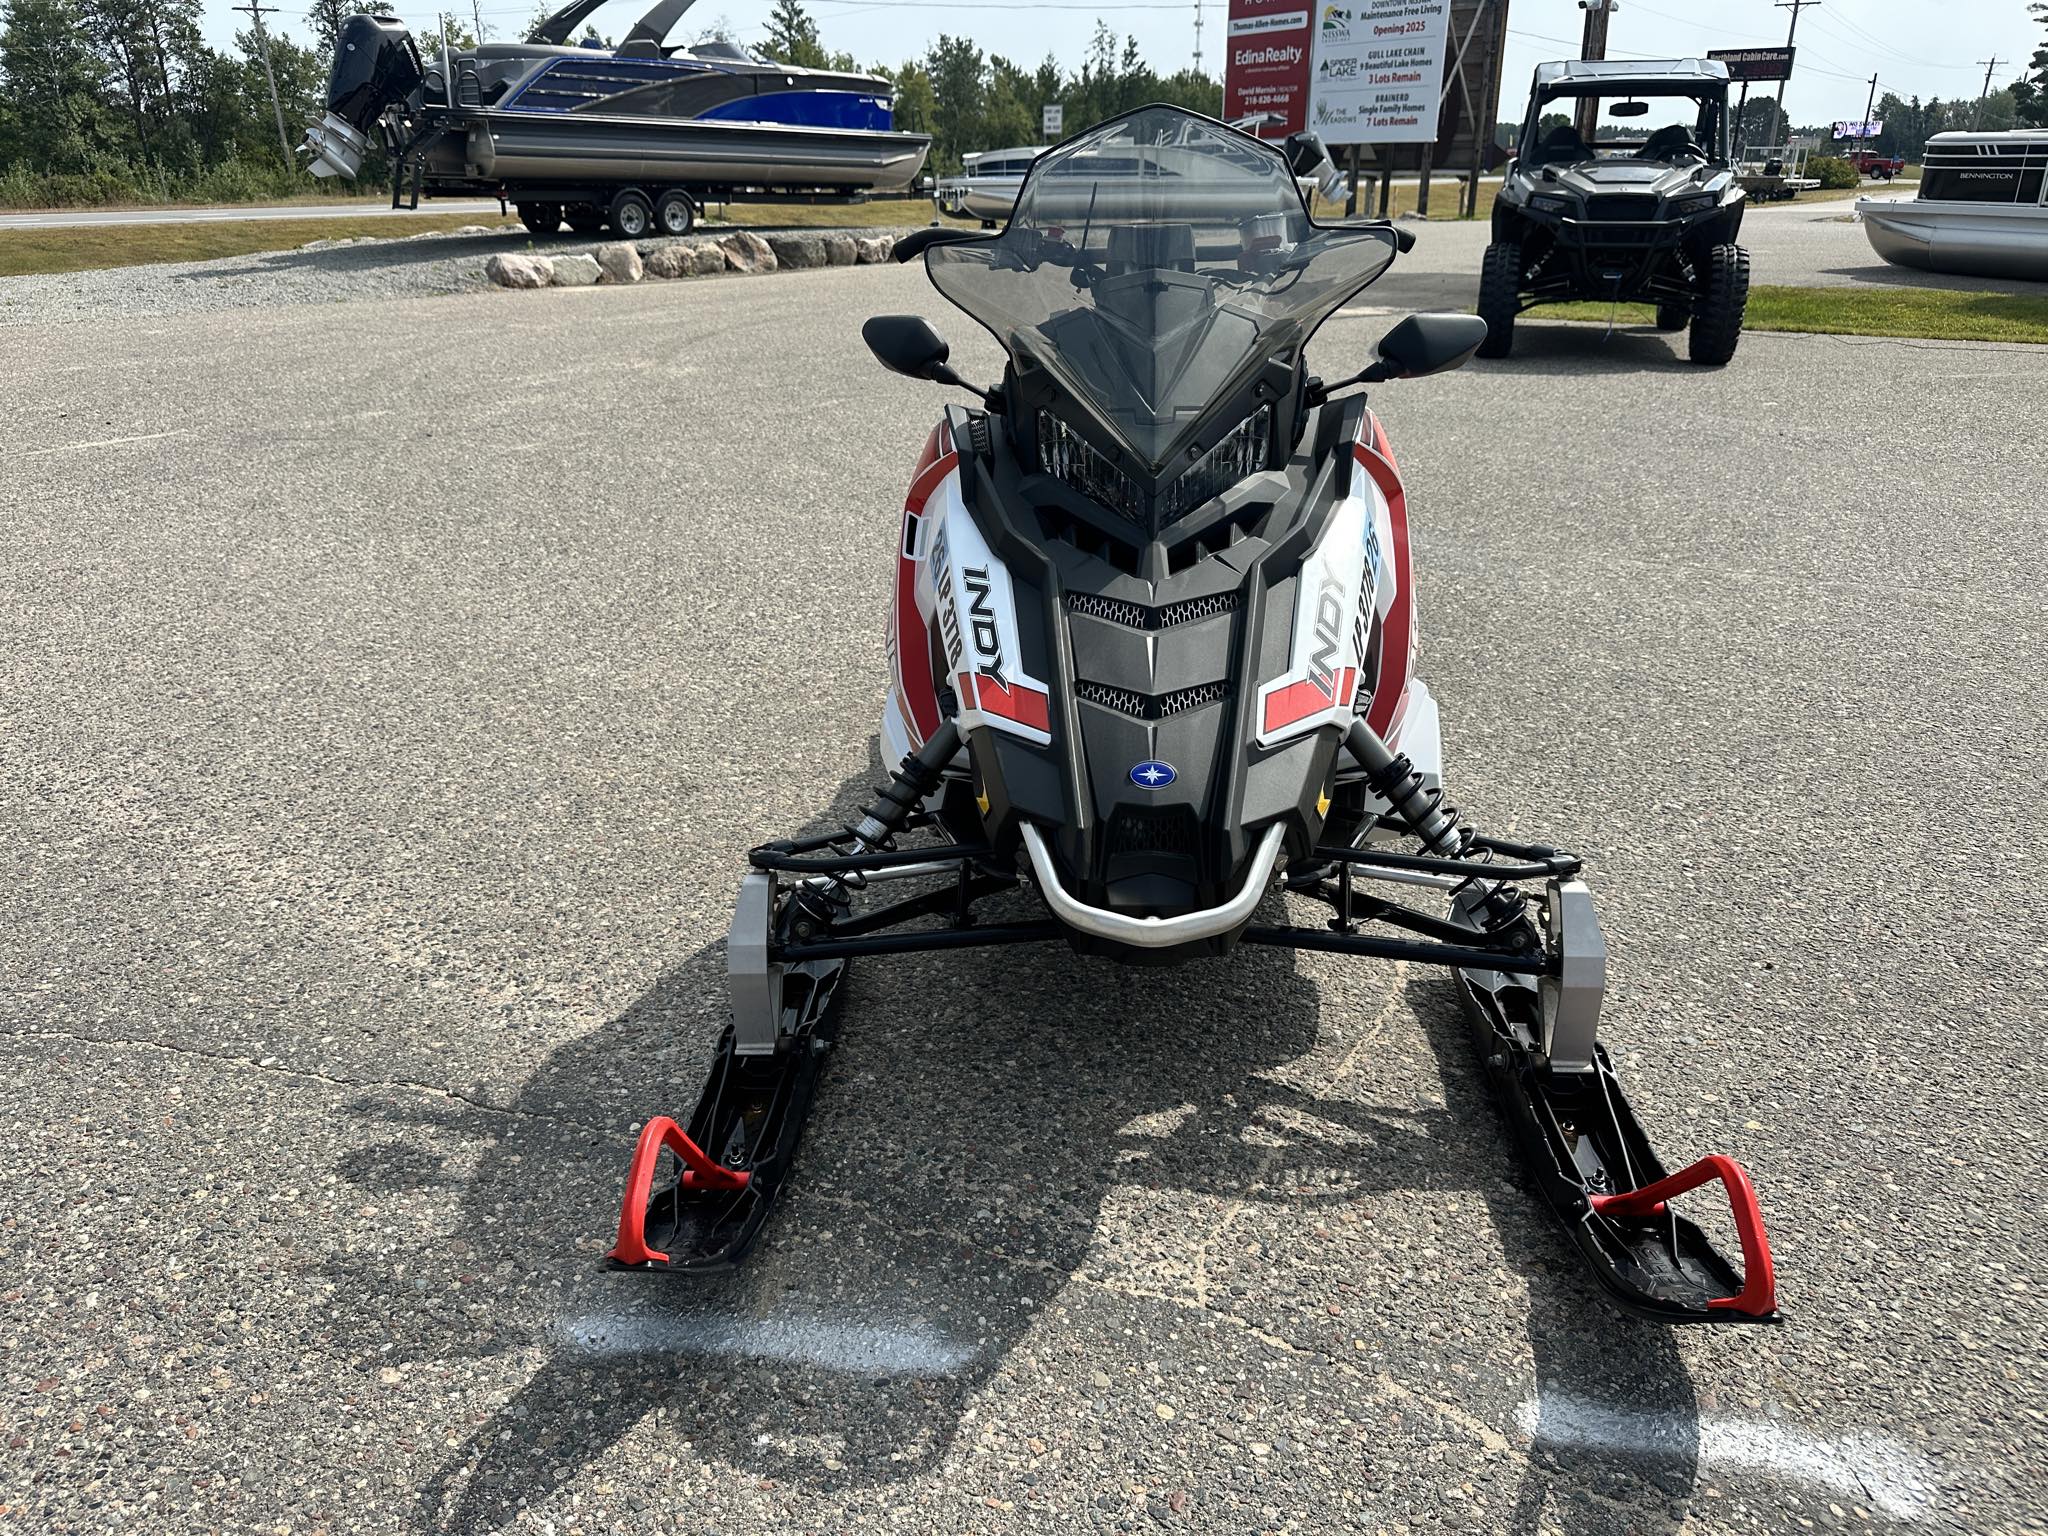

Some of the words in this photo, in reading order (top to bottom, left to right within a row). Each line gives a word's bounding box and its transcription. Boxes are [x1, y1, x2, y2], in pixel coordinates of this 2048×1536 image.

[1360, 10, 1403, 20] Maintenance
[1404, 7, 1419, 16] Free
[1420, 4, 1443, 15] Living
[1373, 24, 1404, 36] Opening
[1406, 21, 1426, 32] 2025
[1235, 48, 1265, 66] Edina
[1265, 45, 1303, 64] Realty
[1368, 50, 1384, 59] GULL
[1386, 48, 1402, 58] LAKE
[1404, 47, 1425, 56] CHAIN
[1330, 58, 1357, 67] SPIDER
[1364, 60, 1393, 71] Beautiful
[1394, 60, 1409, 68] Lake
[1410, 58, 1432, 67] Homes
[1329, 66, 1356, 77] LAKE
[1368, 74, 1374, 84] 3
[1375, 73, 1390, 84] Lots
[1392, 71, 1421, 82] Remain
[1238, 86, 1255, 96] David
[1375, 93, 1409, 103] BRAINERD
[1358, 105, 1378, 116] Single
[1380, 104, 1401, 115] Family
[1402, 104, 1425, 112] Homes
[1367, 117, 1373, 127] 7
[1373, 117, 1388, 127] Lots
[1389, 115, 1418, 126] Remain
[1960, 172, 2014, 180] BENNINGTON
[962, 564, 1011, 696] INDY
[1307, 552, 1346, 702] INDY
